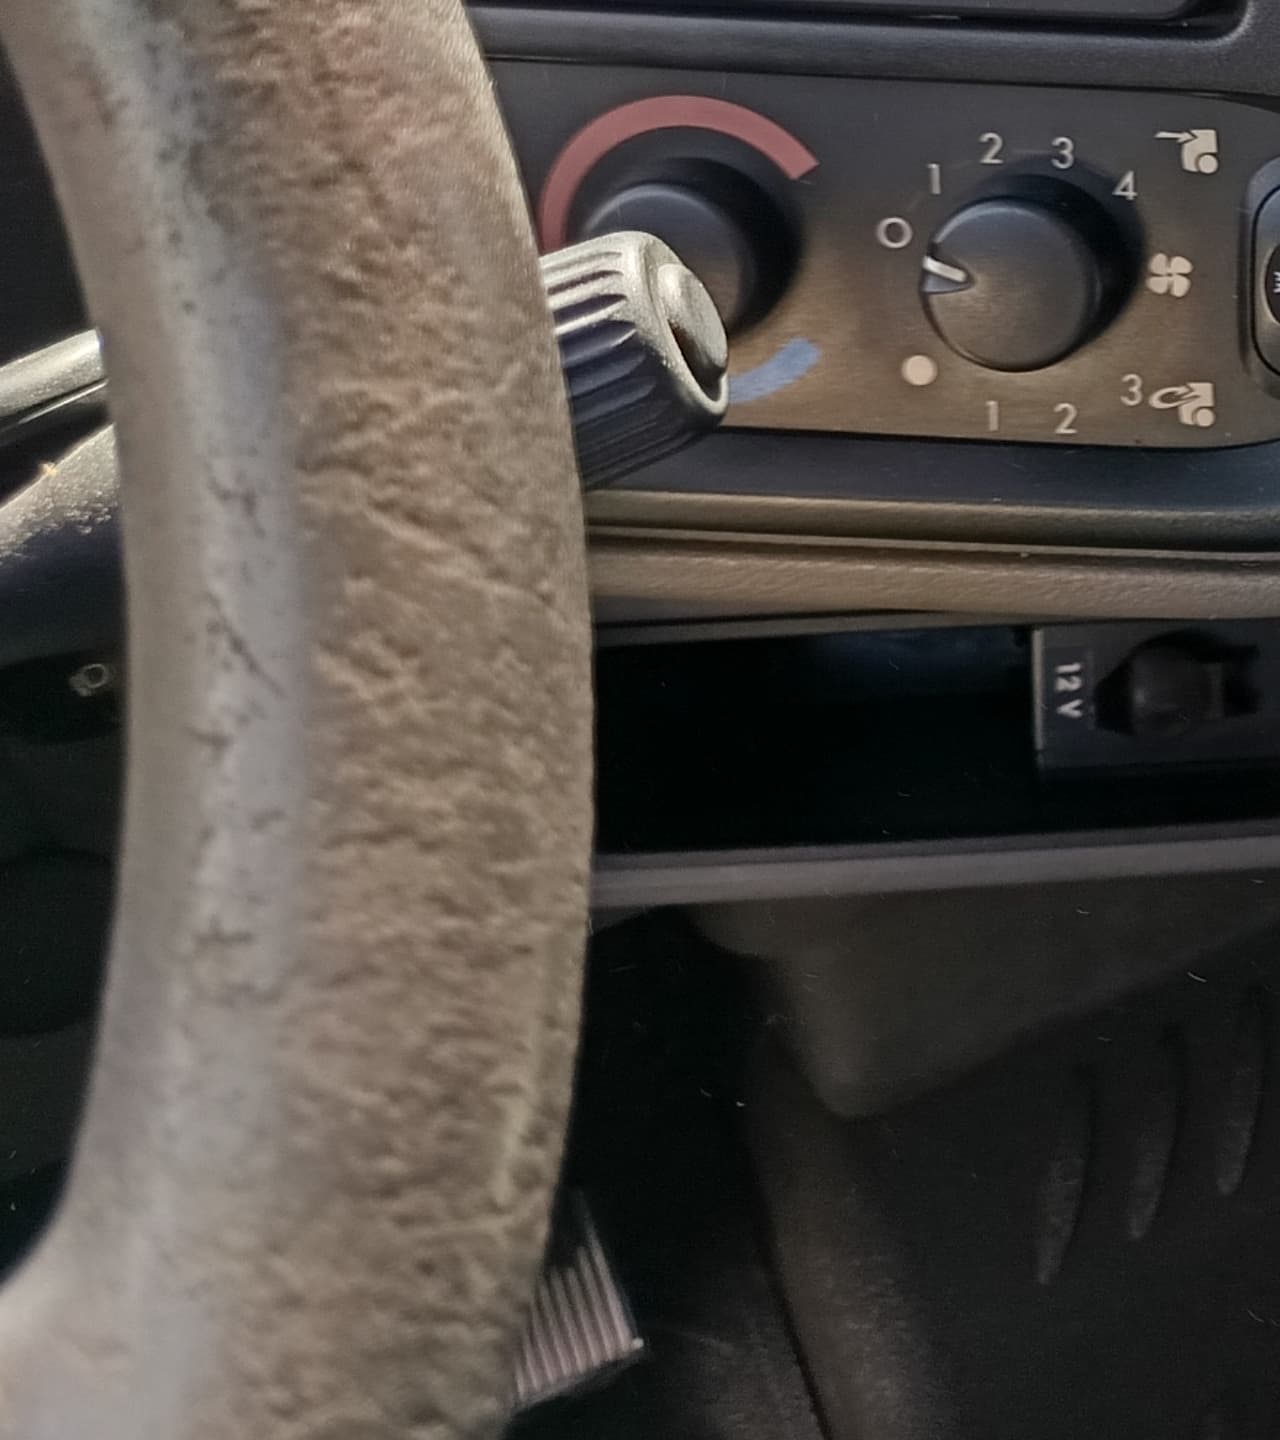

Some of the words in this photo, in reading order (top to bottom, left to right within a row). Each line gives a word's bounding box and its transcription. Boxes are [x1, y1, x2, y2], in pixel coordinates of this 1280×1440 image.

[978, 132, 1005, 165] 2
[1051, 136, 1075, 169] 3
[927, 163, 942, 195] 1
[1111, 170, 1139, 201] 4
[1119, 373, 1143, 407] 3
[985, 400, 1000, 431] 1
[1053, 402, 1078, 434] 2
